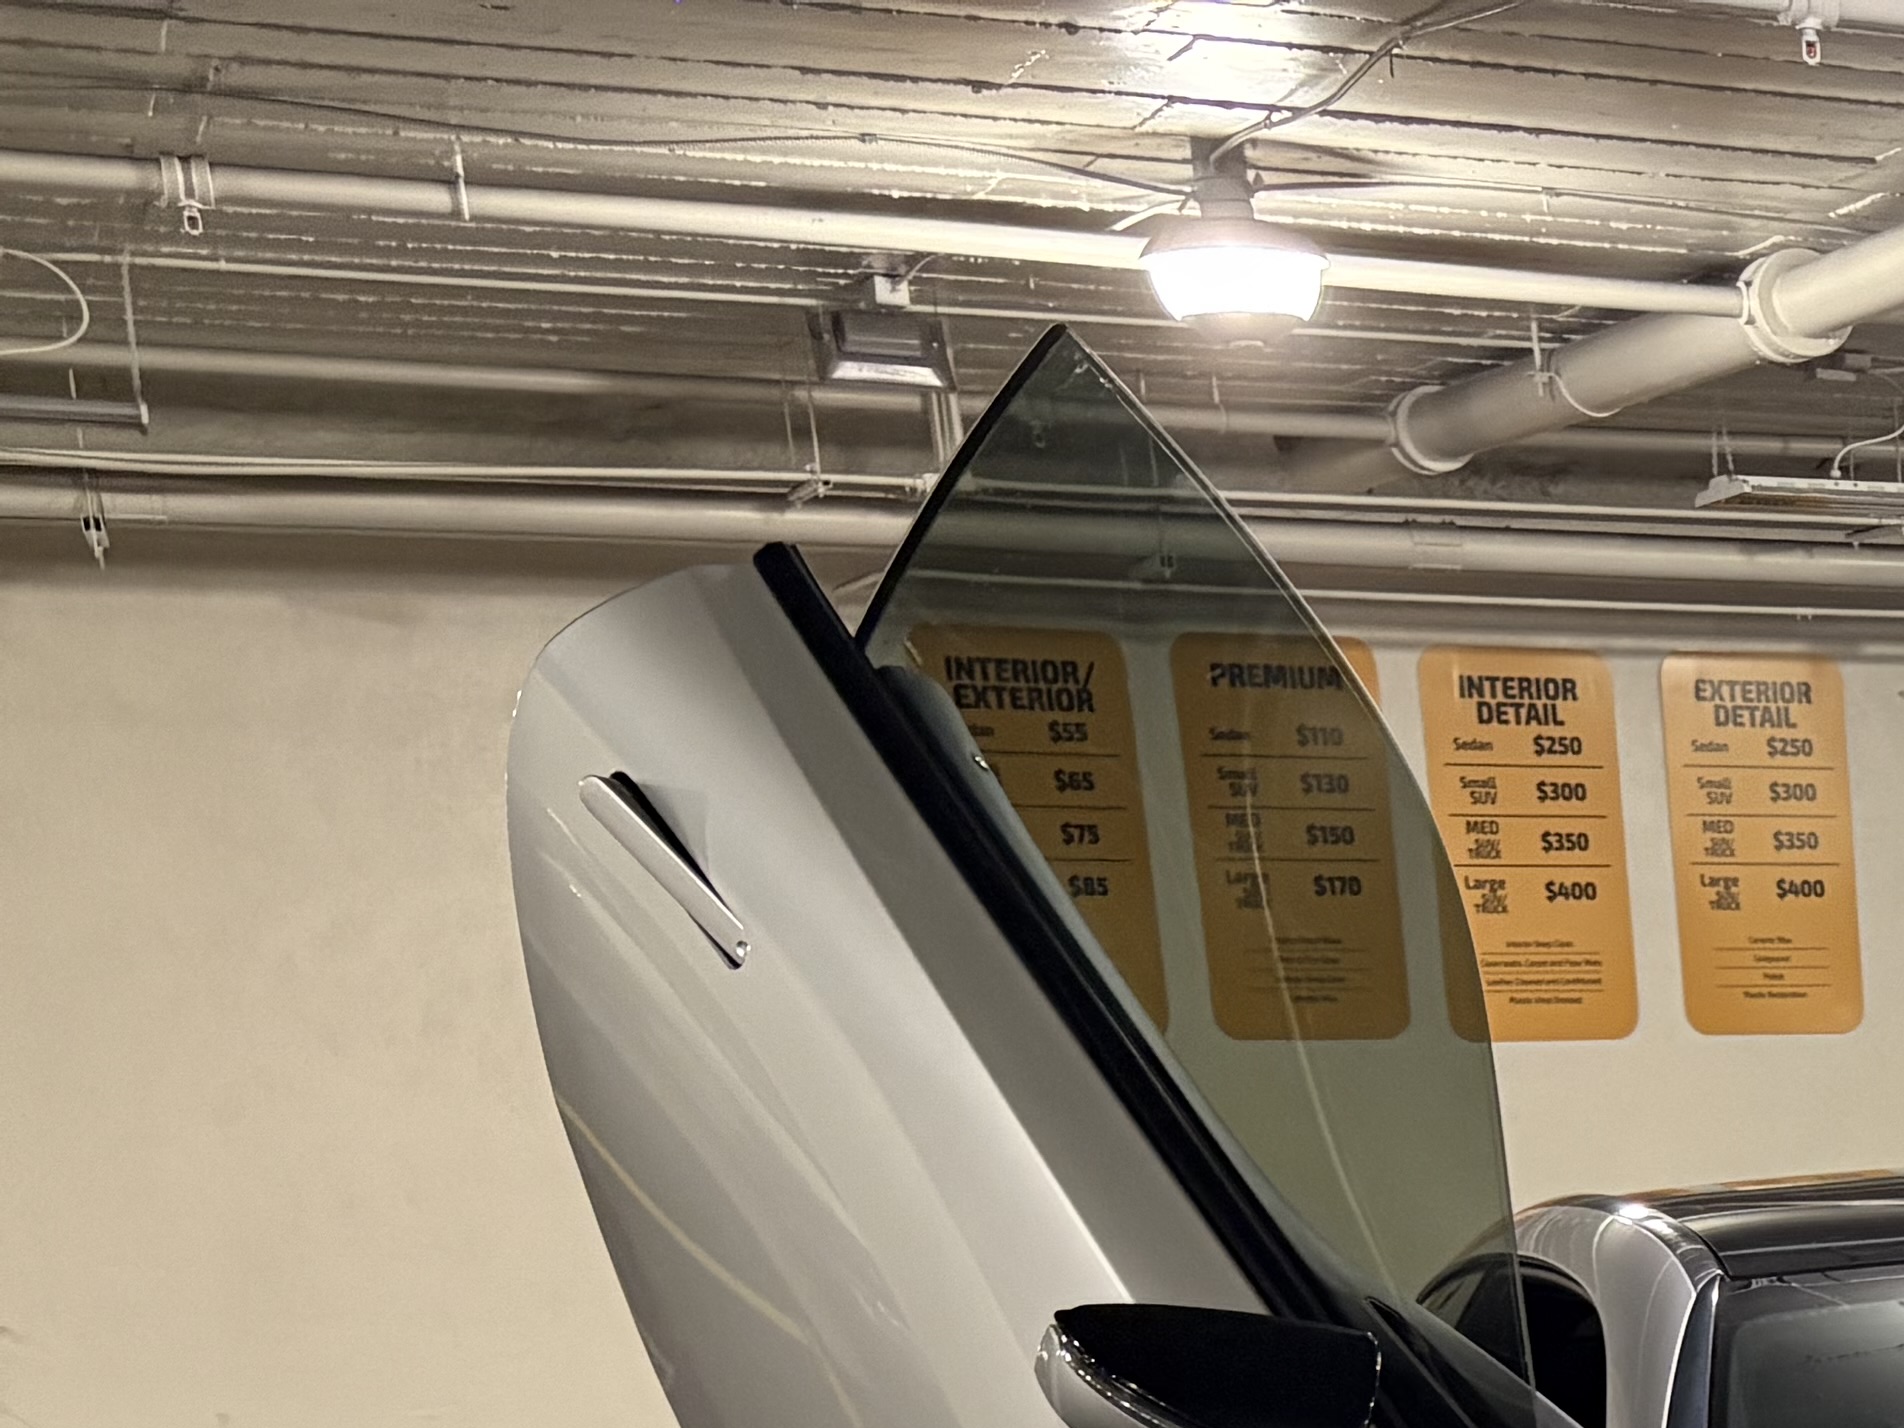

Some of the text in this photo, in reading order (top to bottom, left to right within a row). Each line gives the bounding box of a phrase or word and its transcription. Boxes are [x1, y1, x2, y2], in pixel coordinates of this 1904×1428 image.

[944, 656, 1095, 688] INTERIOR/
[1209, 663, 1345, 690] PREMIUM
[953, 683, 1095, 713] EXTERIOR
[1458, 675, 1579, 701] INTERIOR
[1694, 679, 1813, 705] EXTERIOR
[1476, 701, 1566, 726] DETAIL
[1714, 704, 1798, 729] DETAIL
[1452, 734, 1582, 757] Sedan $250
[1690, 736, 1814, 758] Sedan $250
[1469, 790, 1498, 805] SUV
[1536, 780, 1587, 803] $300
[1705, 791, 1733, 805] SUV
[1768, 781, 1818, 803] $300
[1060, 822, 1100, 846] $75
[1306, 822, 1356, 846] $150
[1465, 820, 1500, 835] MED
[1702, 820, 1734, 835] MED
[1540, 831, 1590, 854] $350
[1772, 830, 1820, 852] $350
[1312, 874, 1363, 897] $170
[1464, 876, 1507, 895] Large
[1544, 880, 1598, 904] $400
[1700, 873, 1740, 892] Large
[1776, 878, 1826, 901] $400
